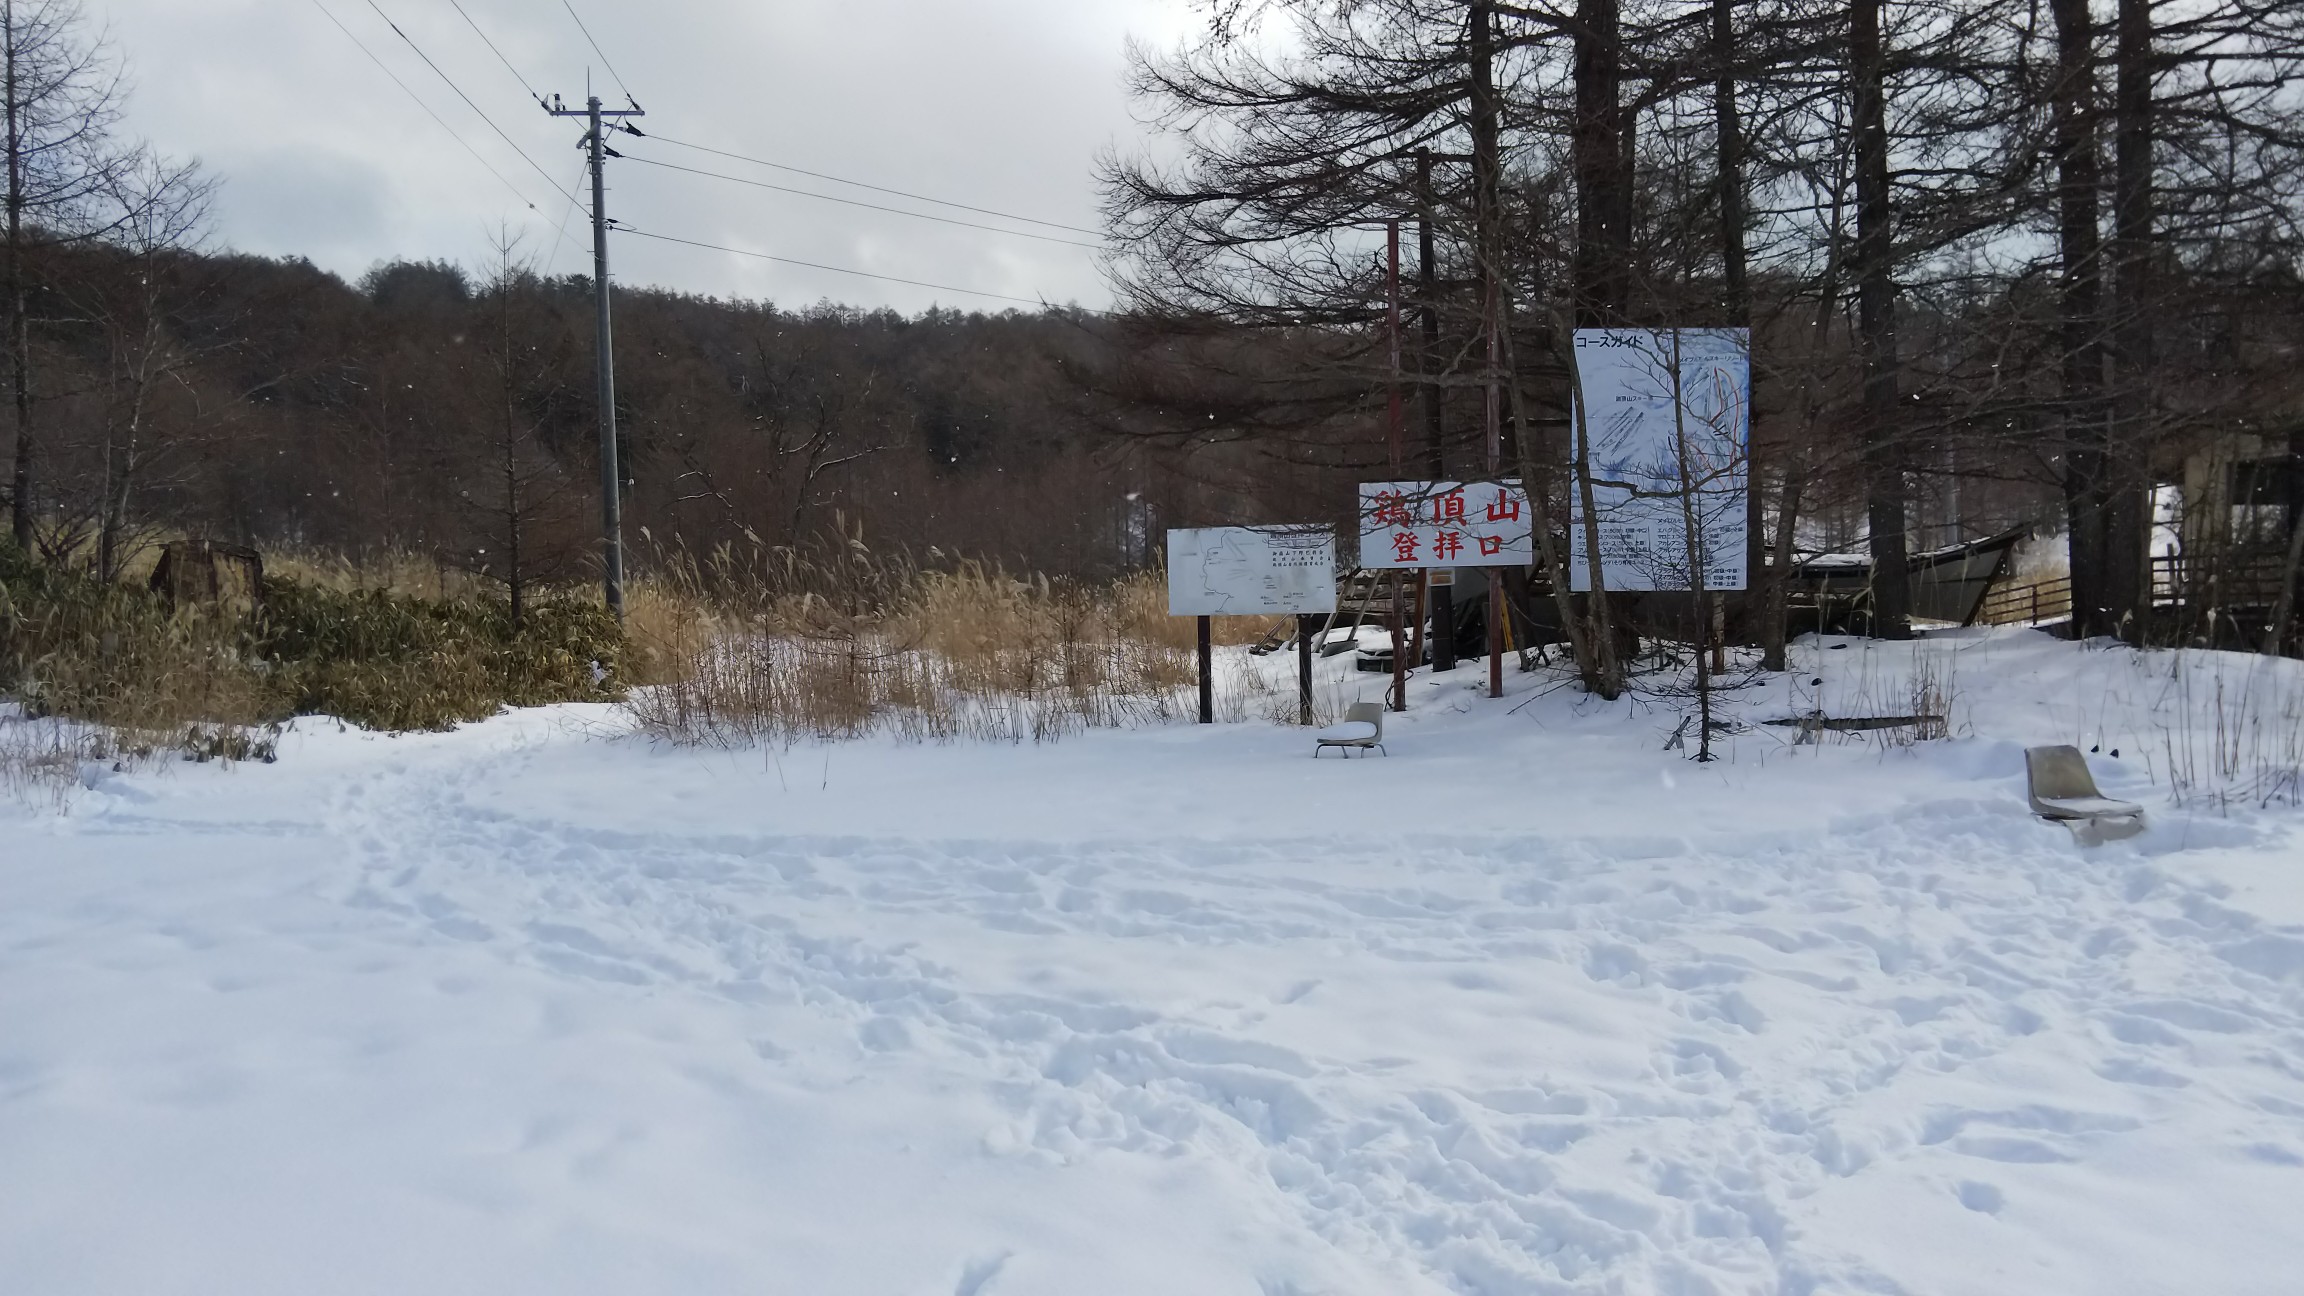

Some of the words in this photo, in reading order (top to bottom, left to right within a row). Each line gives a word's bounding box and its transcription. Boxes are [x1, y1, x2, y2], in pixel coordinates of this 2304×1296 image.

[1576, 335, 1643, 349] コースガイド
[1373, 488, 1520, 528] 鶏頂山
[1391, 531, 1503, 563] 登拝口
